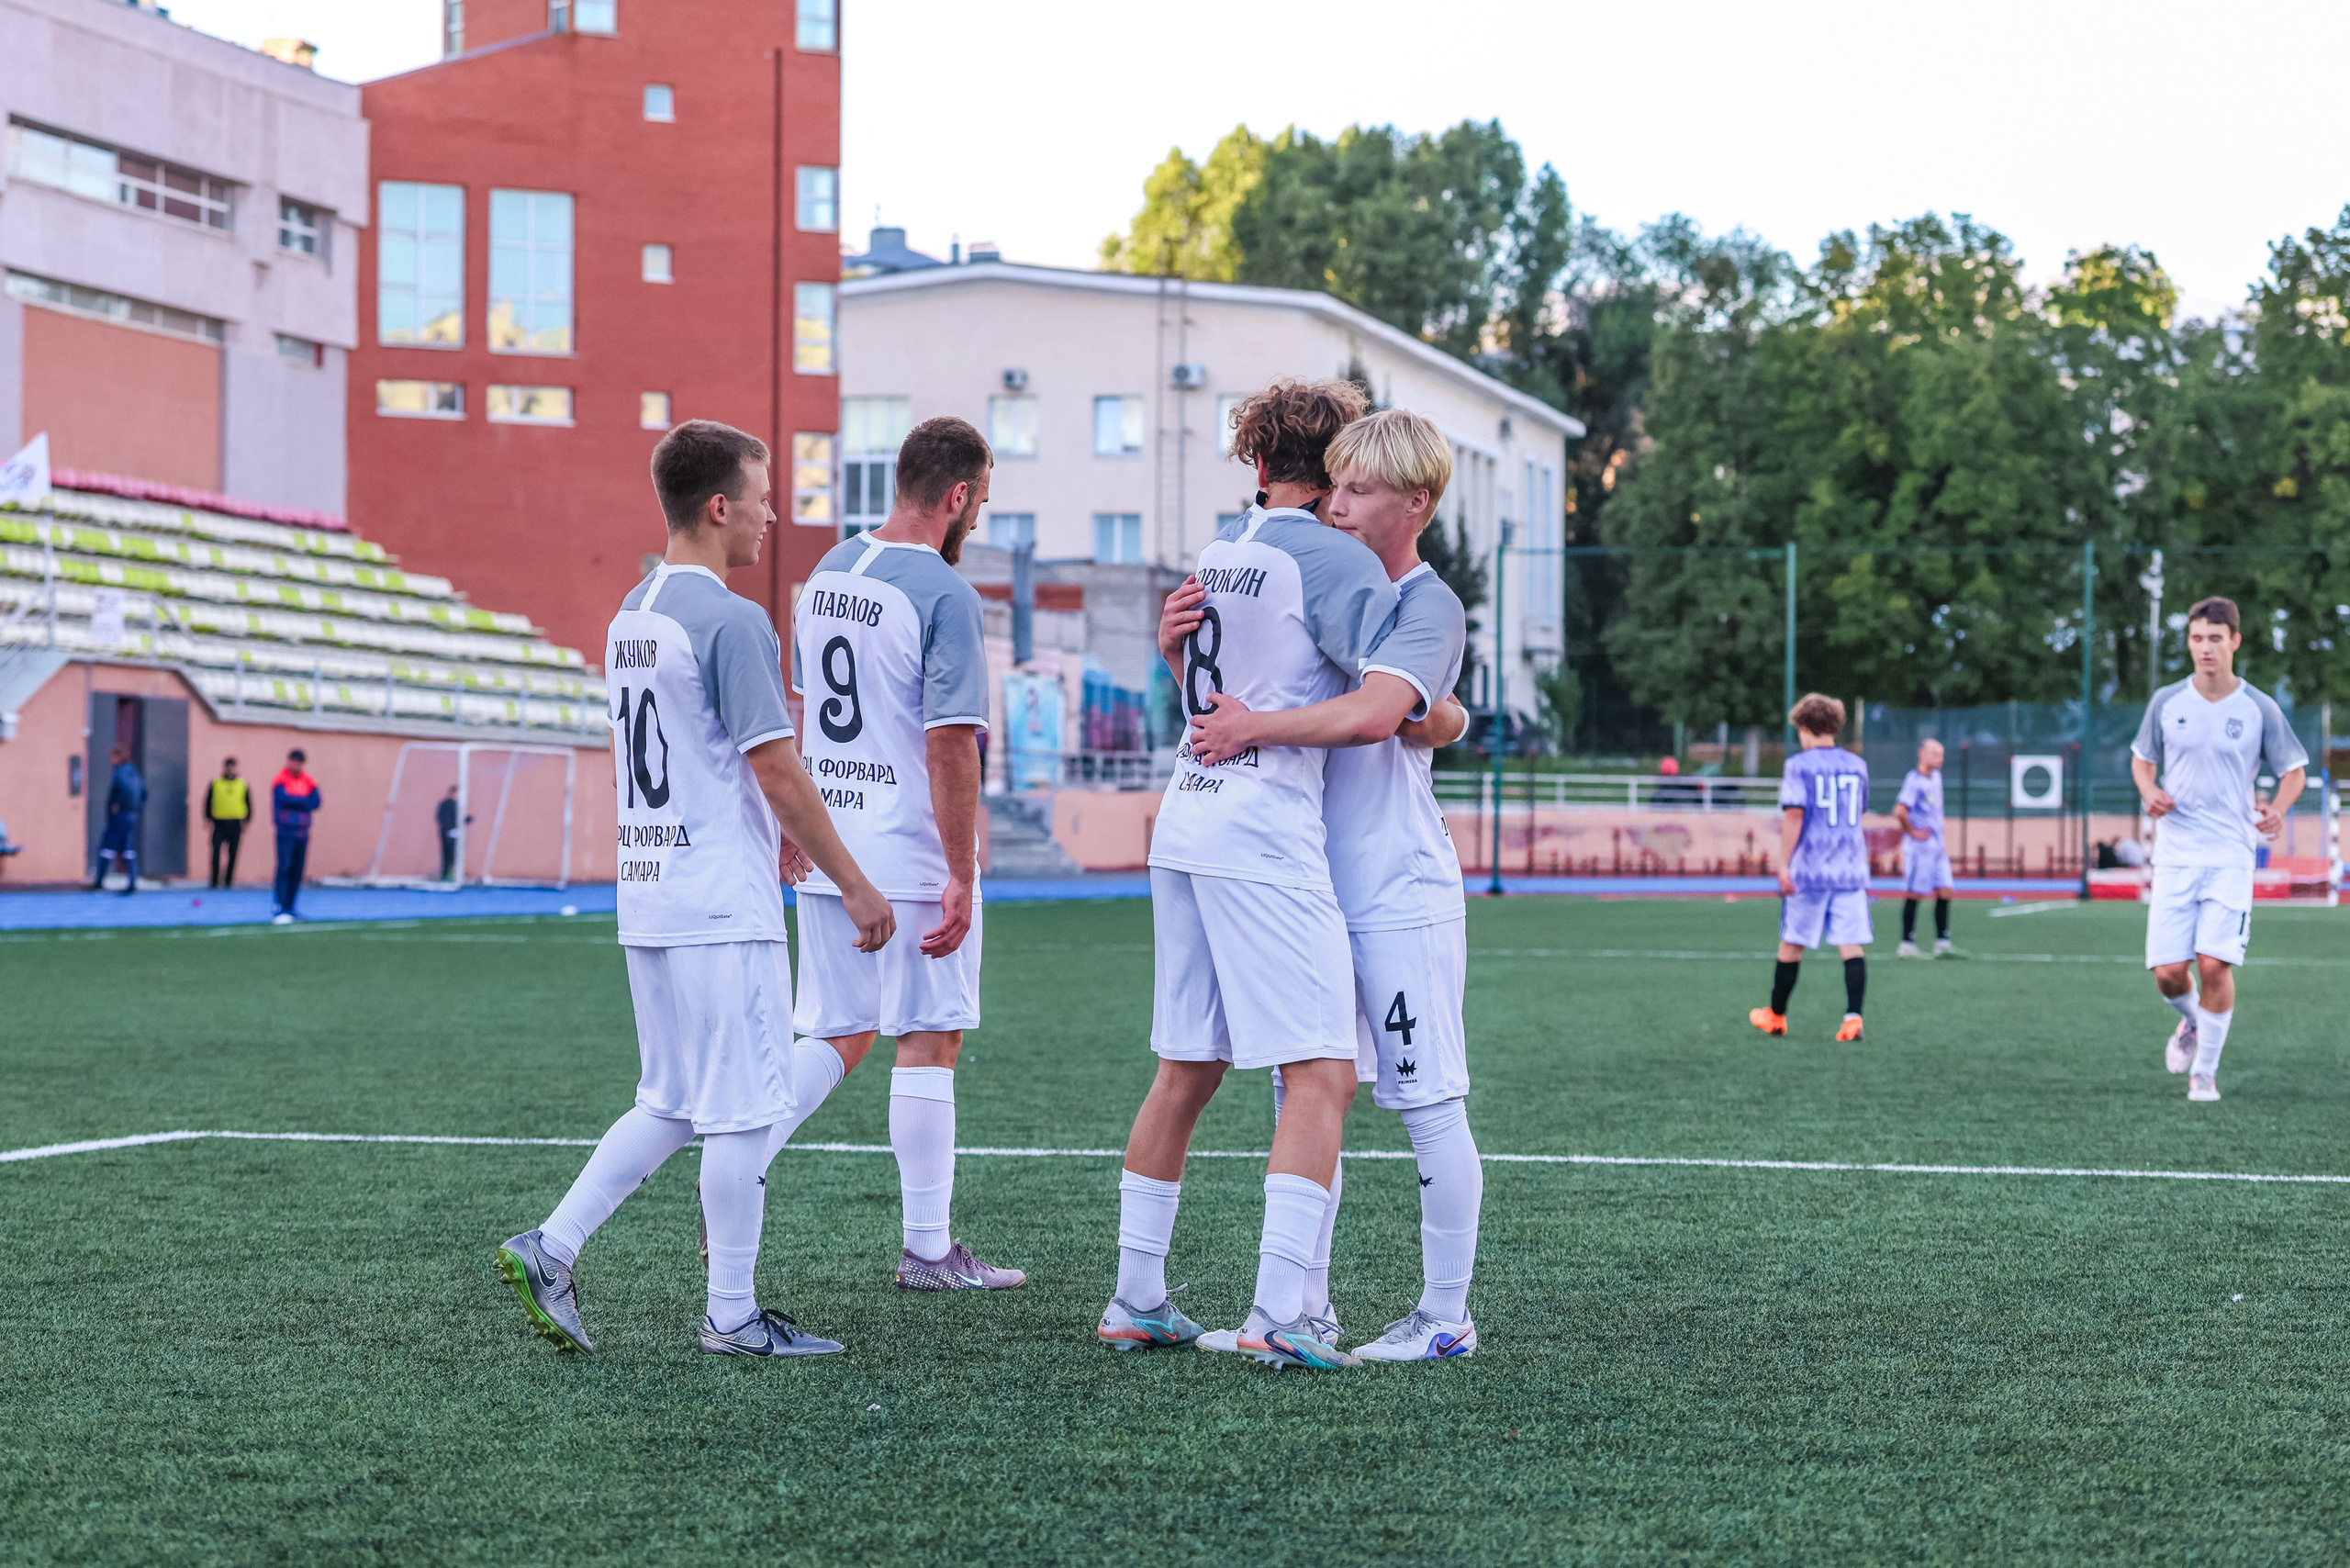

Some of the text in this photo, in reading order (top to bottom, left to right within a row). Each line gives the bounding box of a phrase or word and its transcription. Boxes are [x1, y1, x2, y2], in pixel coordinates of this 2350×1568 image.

[1196, 566, 1268, 598] ОРОКИН
[811, 590, 884, 628] ПАВЛОВ
[614, 639, 658, 670] ЖУКОВ
[1186, 606, 1223, 715] 8
[819, 634, 864, 744] 9
[617, 686, 670, 810] 10
[818, 757, 898, 786] ФОРВАРД
[820, 787, 864, 811] МАРА
[1815, 773, 1860, 827] 47
[621, 860, 661, 882] САМАРА
[1384, 991, 1417, 1046] 4
